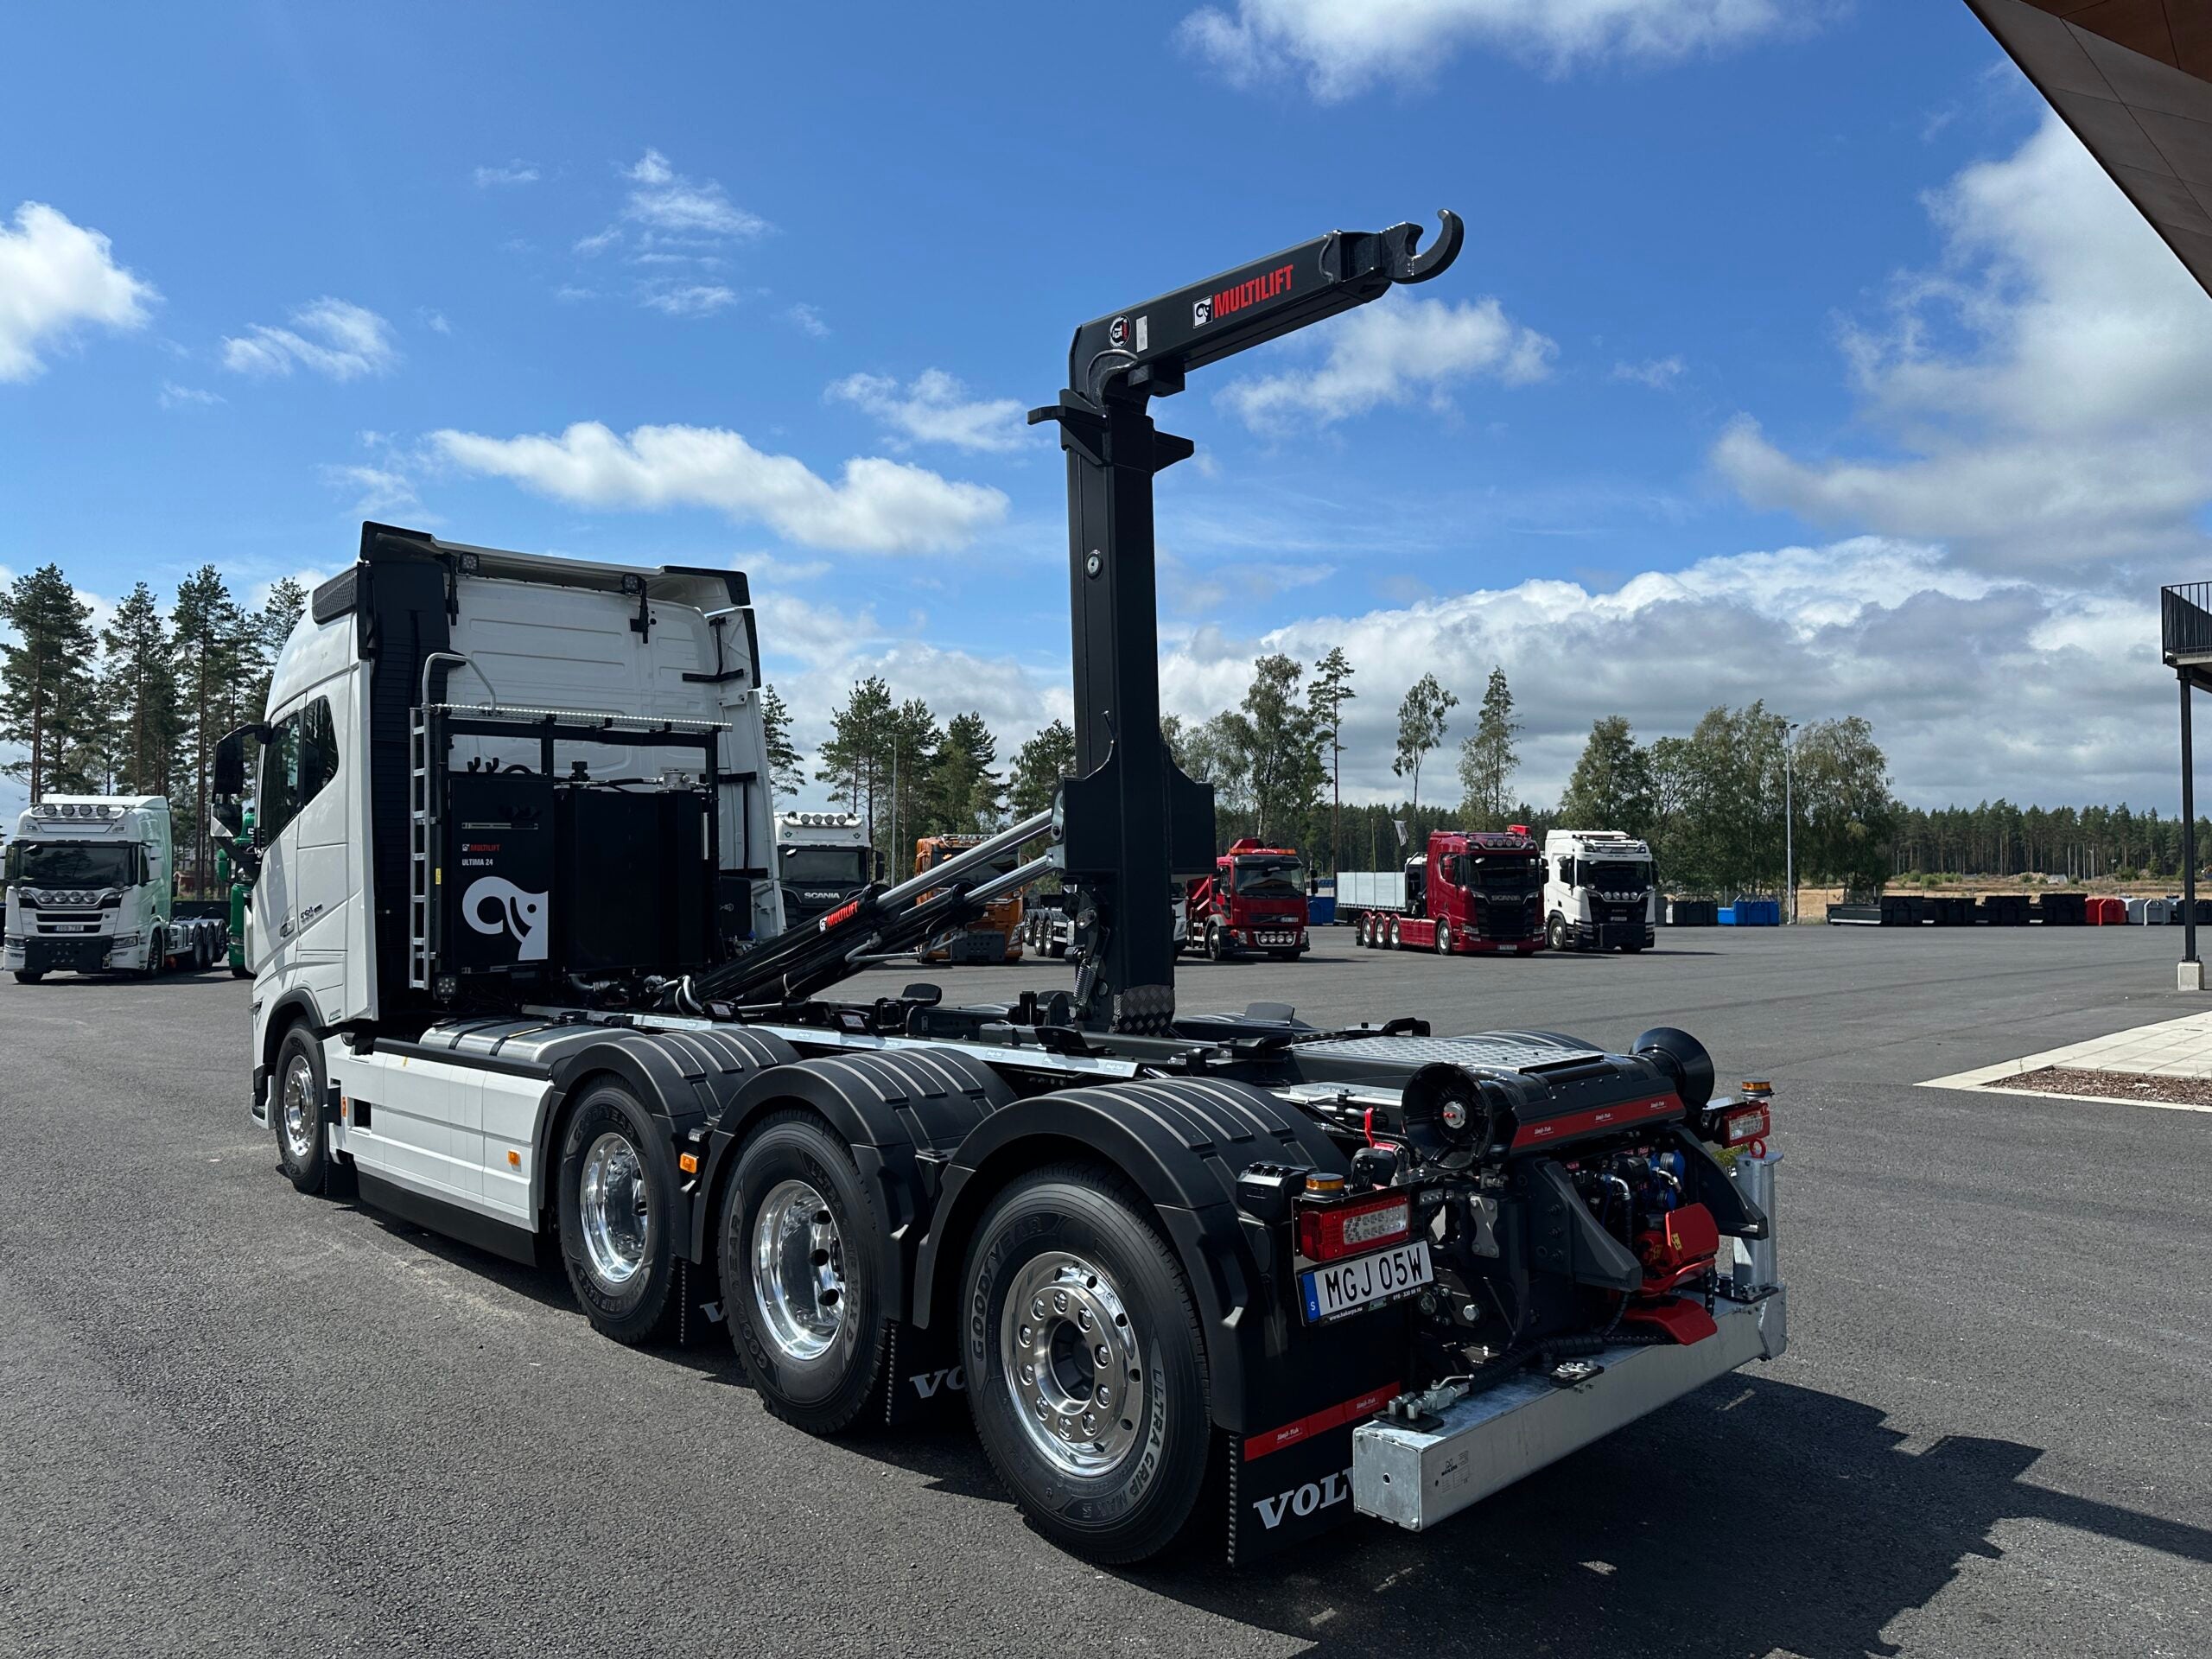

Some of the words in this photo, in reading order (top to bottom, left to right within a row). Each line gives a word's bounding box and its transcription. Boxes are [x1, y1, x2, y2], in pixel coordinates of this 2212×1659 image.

[1214, 264, 1294, 319] MULTILIFT
[470, 843, 501, 852] MULTILIFT
[826, 900, 859, 927] MULTILIFT
[971, 1215, 1044, 1361] GOODYEAR
[1325, 1262, 1372, 1308] MGJ
[1378, 1247, 1423, 1291] 05W
[1310, 1301, 1316, 1311] S
[1147, 1368, 1166, 1451] ULTRA
[1128, 1452, 1156, 1498] GRIP
